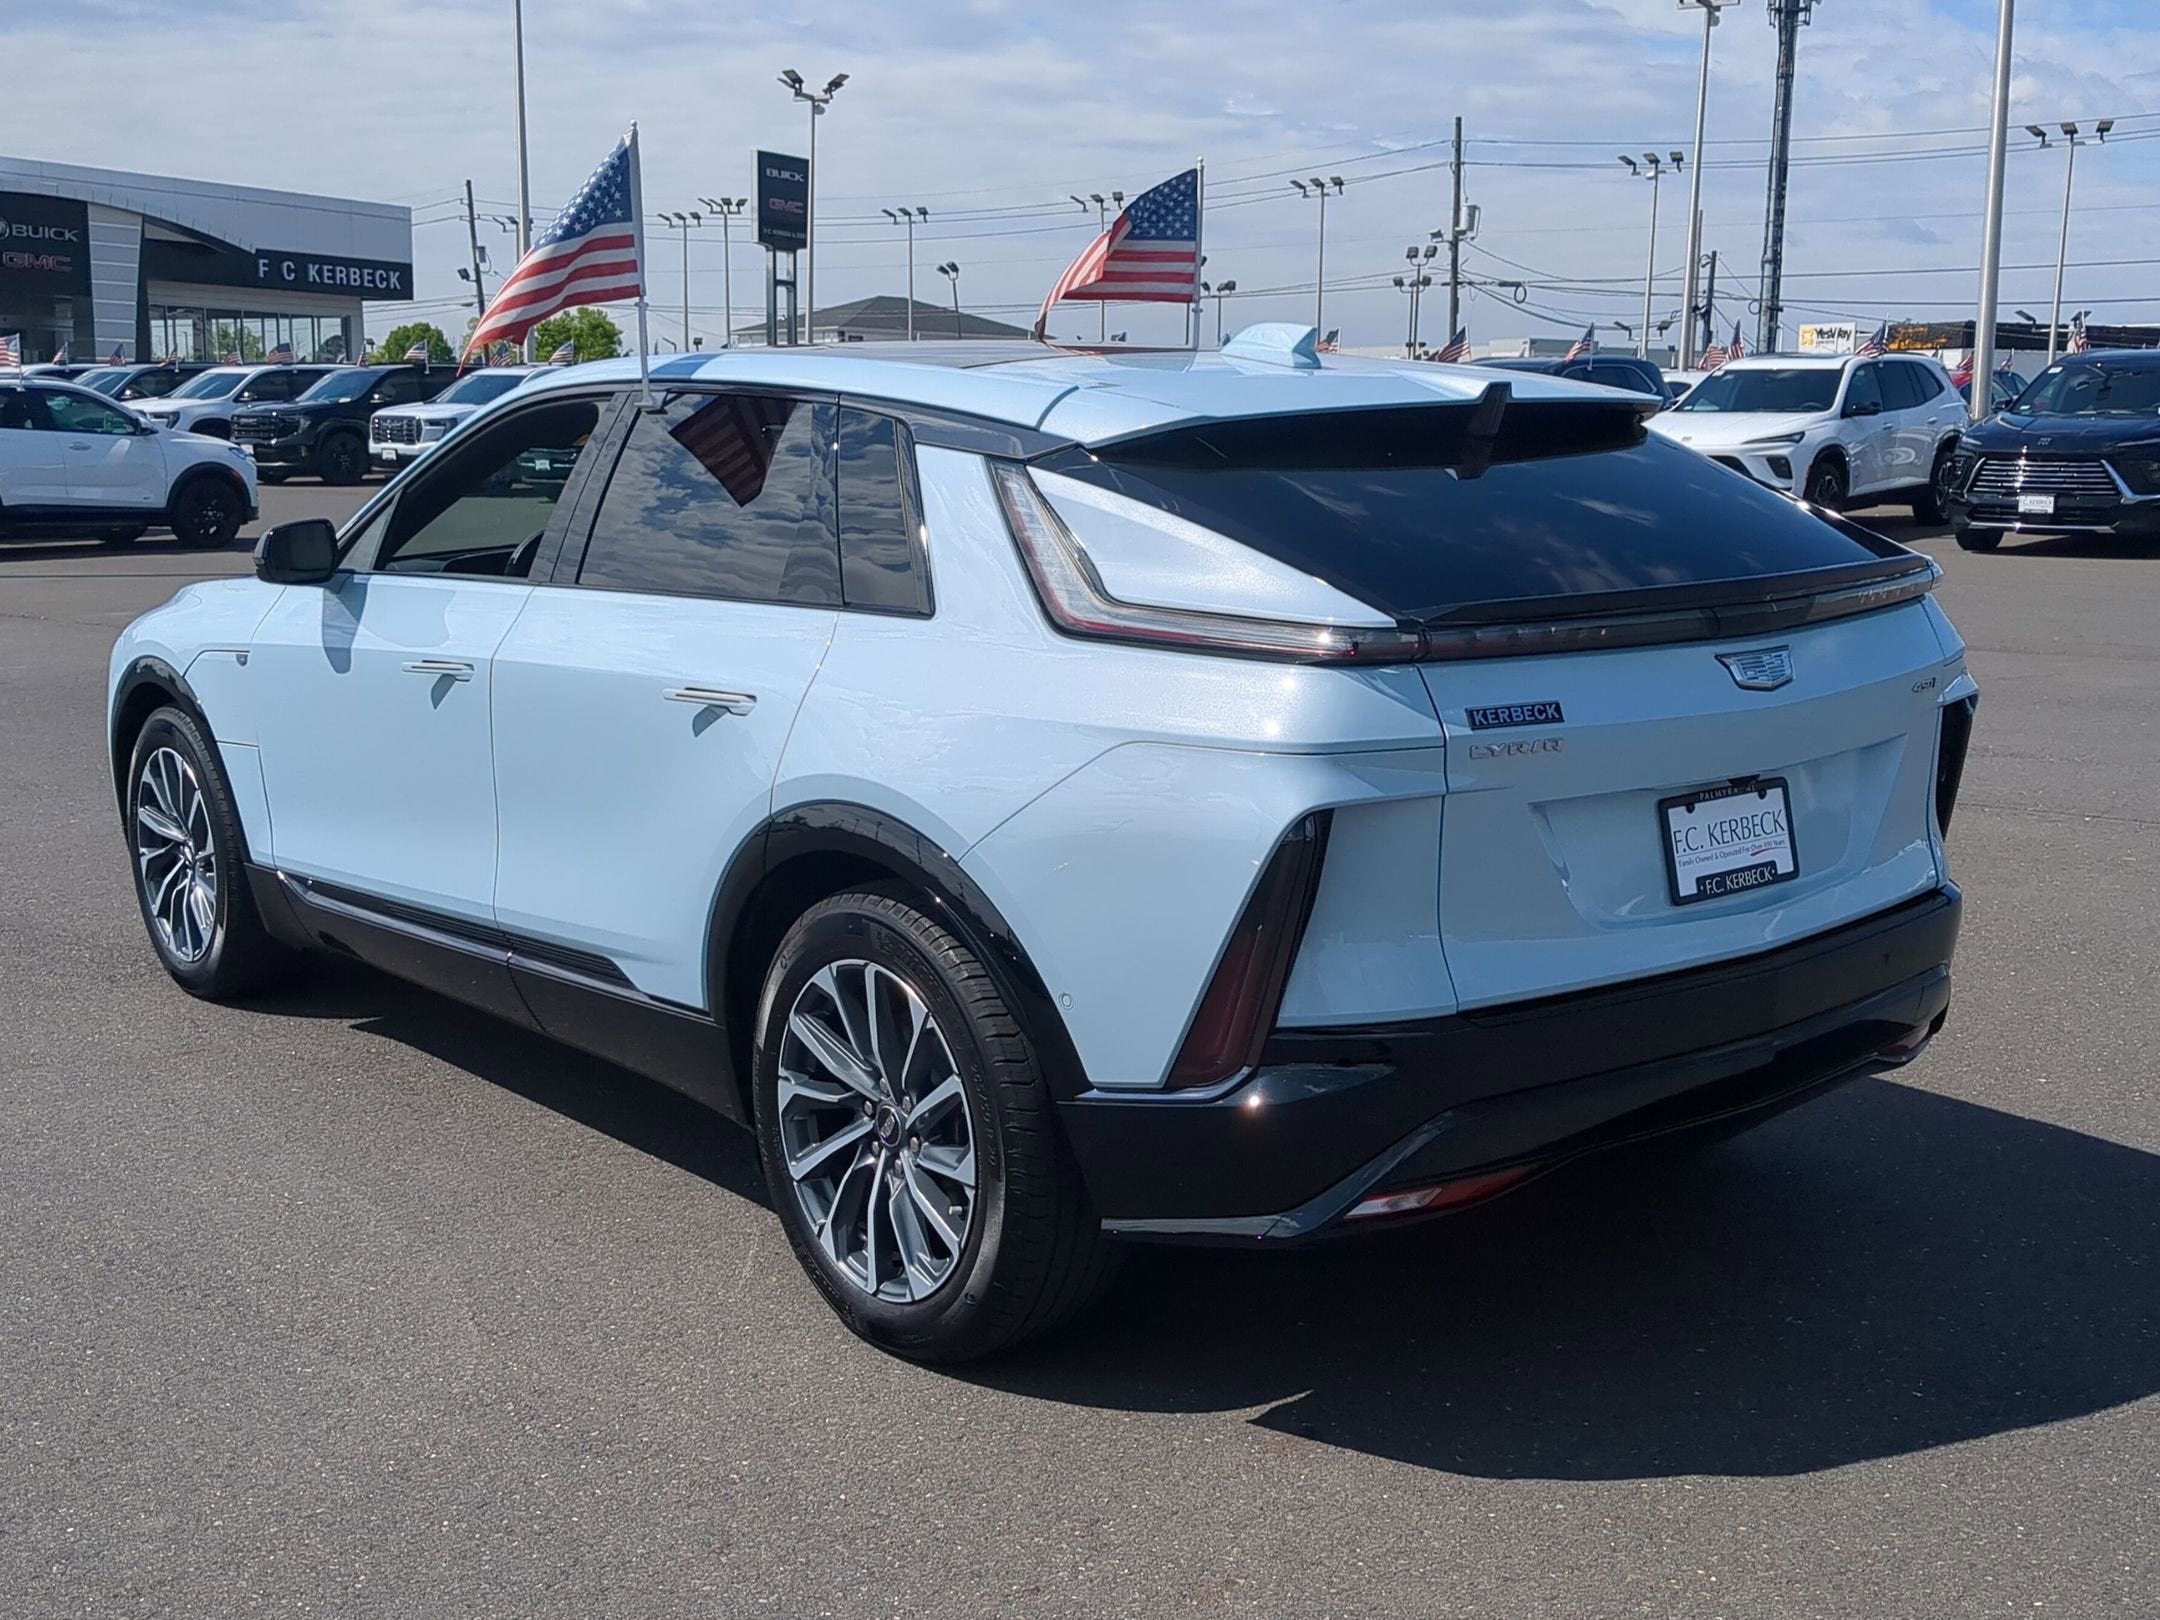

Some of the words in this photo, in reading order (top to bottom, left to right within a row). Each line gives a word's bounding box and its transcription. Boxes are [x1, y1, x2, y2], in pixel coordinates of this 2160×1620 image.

[765, 168, 805, 182] BUICK
[768, 198, 803, 214] GMC
[12, 224, 79, 242] BUICK
[2, 251, 72, 272] GMC
[258, 258, 270, 278] F
[281, 260, 296, 281] C
[307, 263, 402, 290] KERBECK
[1472, 703, 1561, 726] KERBECK
[1469, 738, 1565, 760] LYRIQ
[1672, 826, 1704, 855] F.C.
[1707, 809, 1786, 847] KERBECK
[1705, 876, 1725, 895] F.C.
[1725, 865, 1773, 890] KERBECK
